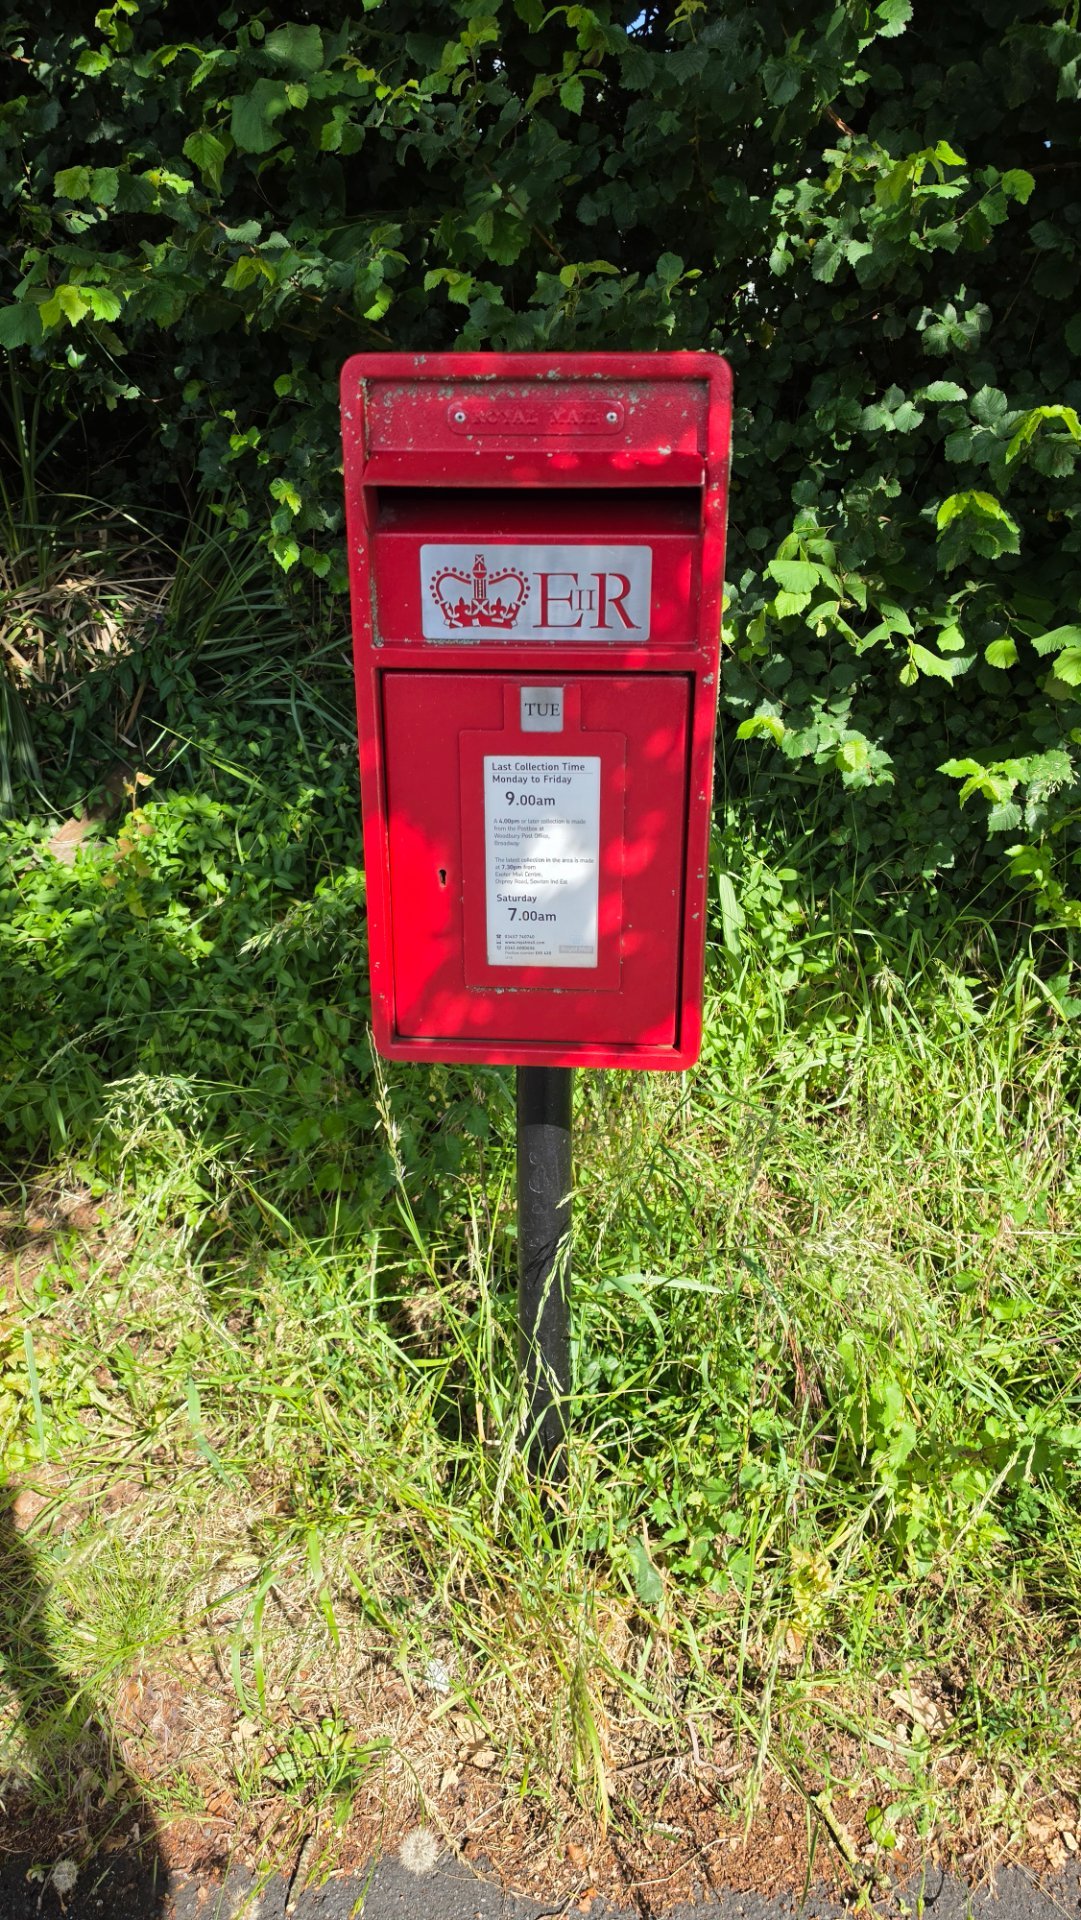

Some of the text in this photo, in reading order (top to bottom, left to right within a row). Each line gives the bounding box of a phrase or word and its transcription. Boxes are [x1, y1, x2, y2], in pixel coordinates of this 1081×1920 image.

[472, 409, 599, 425] ROYAL MAIL
[524, 702, 561, 717] TUE
[492, 762, 585, 771] Last Collection Time
[492, 775, 572, 785] Monday to Friday
[505, 791, 556, 806] 9.00am
[496, 893, 537, 904] Saturday
[508, 907, 557, 922] 7.00am
